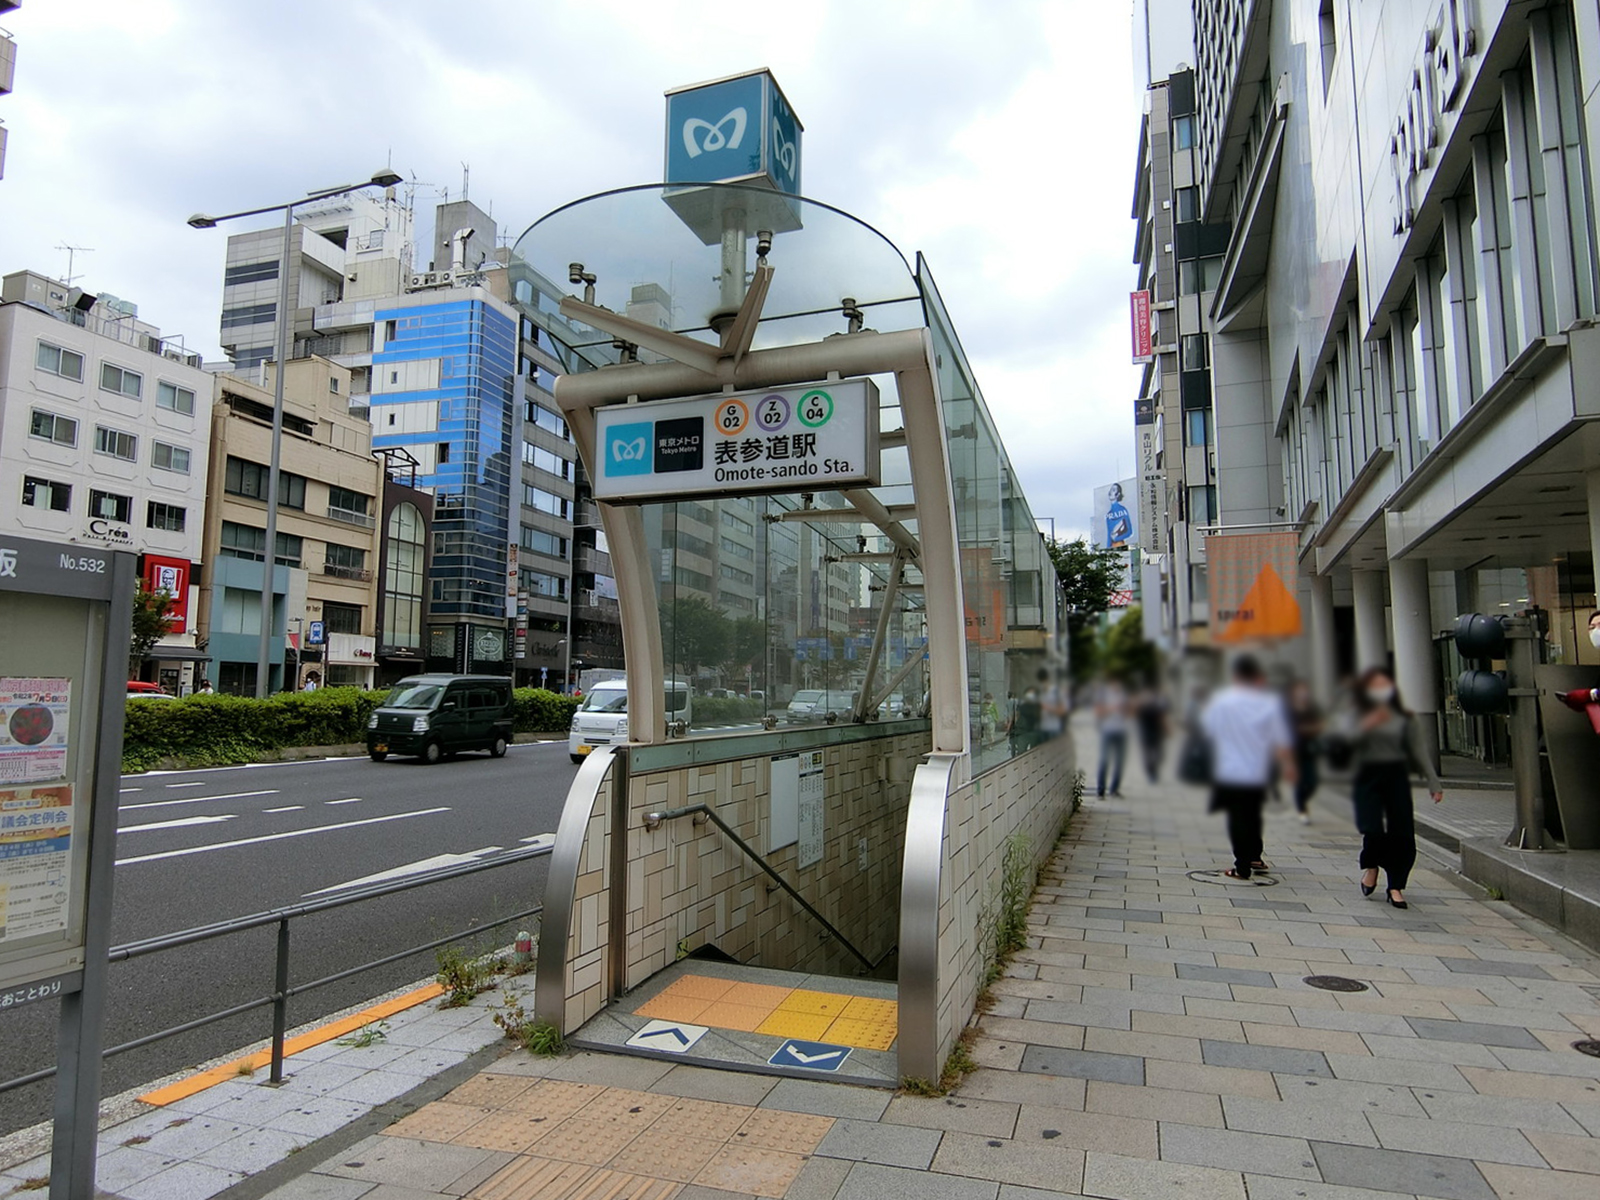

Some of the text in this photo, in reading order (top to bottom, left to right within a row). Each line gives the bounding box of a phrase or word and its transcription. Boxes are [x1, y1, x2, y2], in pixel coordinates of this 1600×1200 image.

[768, 401, 777, 412] Z
[811, 396, 819, 407] C
[727, 405, 737, 416] G
[806, 408, 824, 420] 04
[723, 417, 740, 429] 02
[764, 412, 781, 424] 02
[659, 435, 700, 448] 東京メトロ
[661, 447, 679, 455] Tokyo
[714, 433, 817, 465] 表参道駅
[714, 458, 855, 483] Omote-sando Sta.
[90, 520, 129, 539] Créa
[60, 553, 106, 574] No.532
